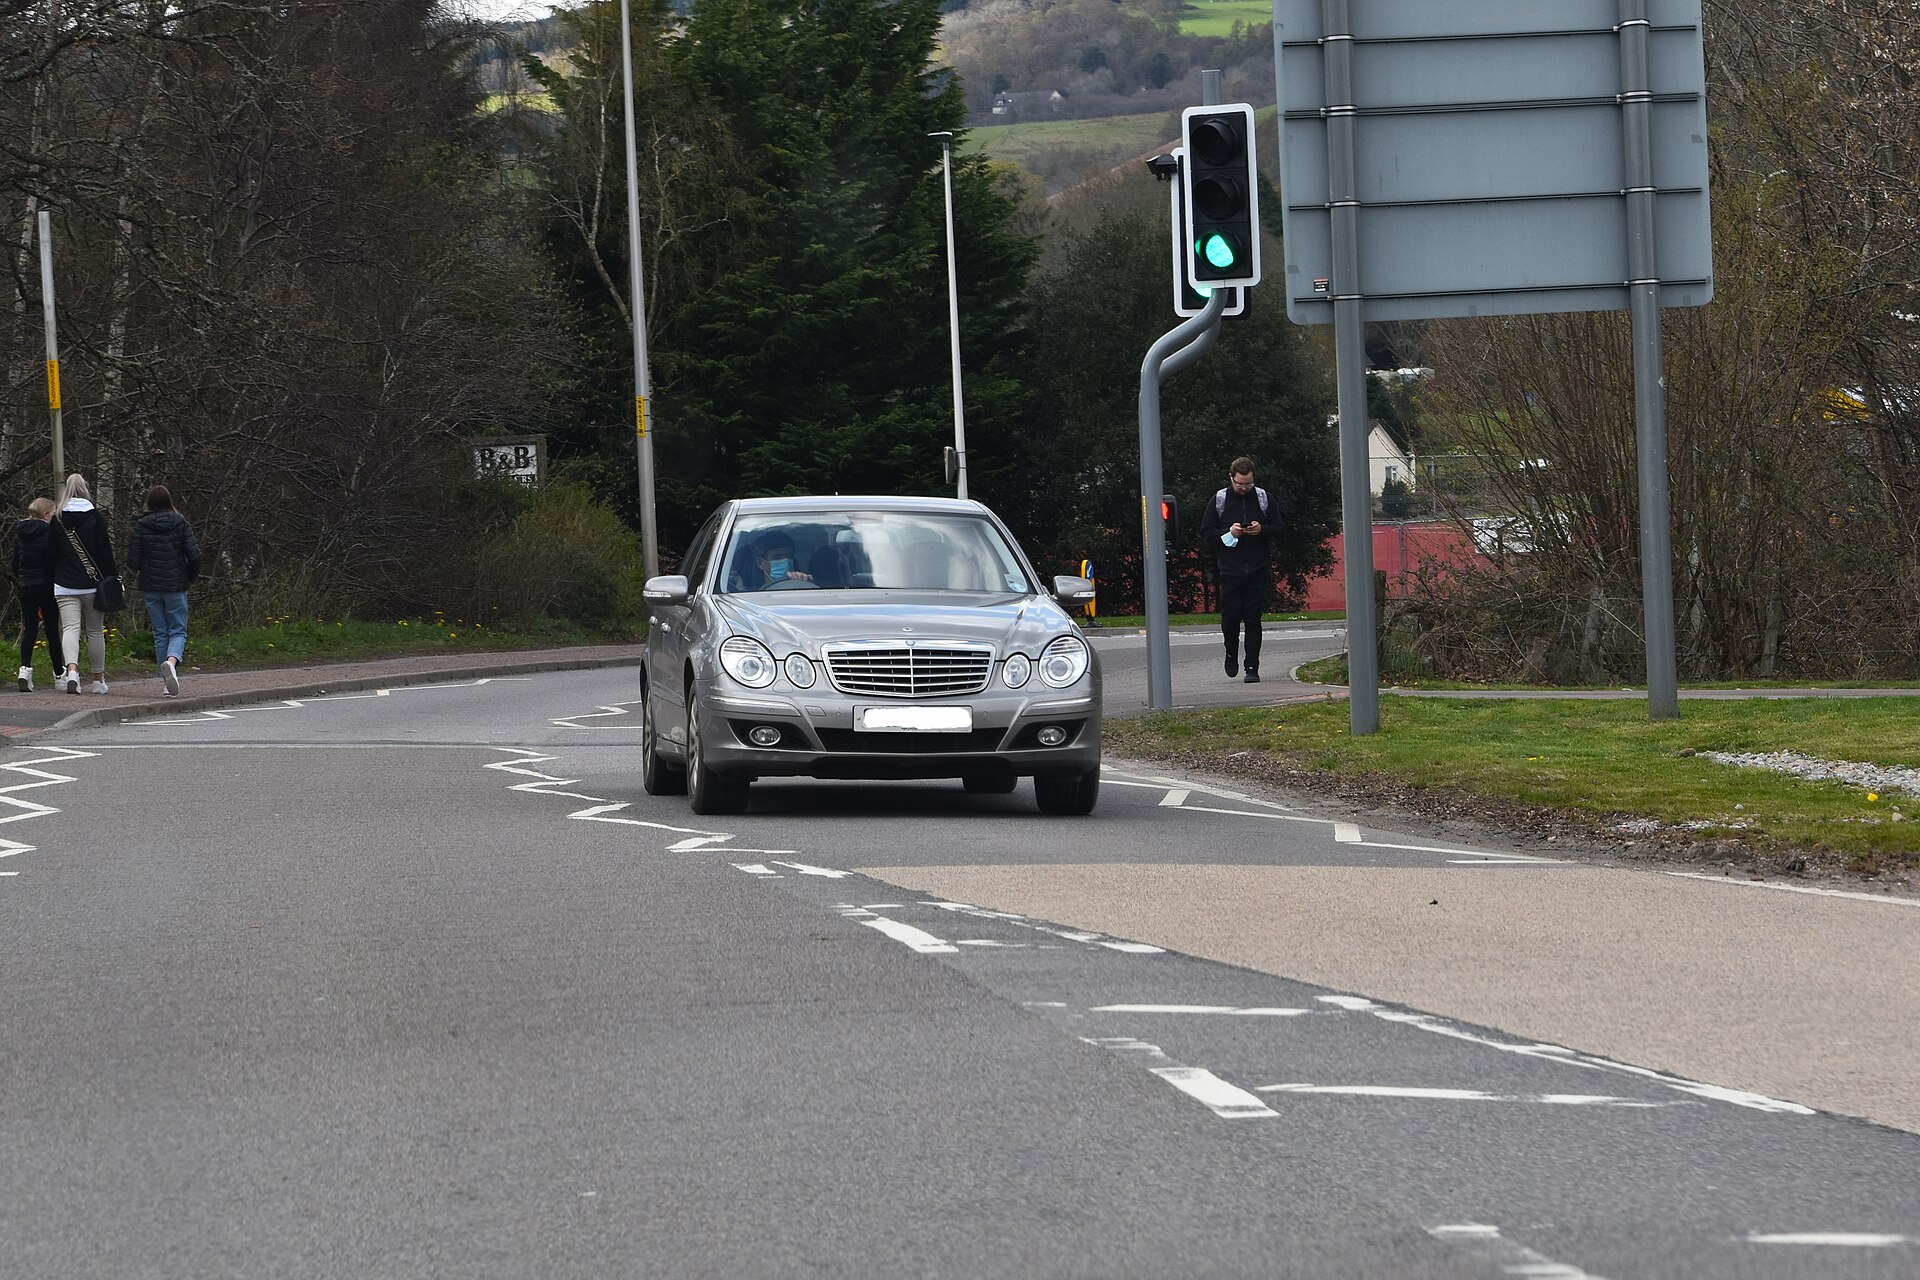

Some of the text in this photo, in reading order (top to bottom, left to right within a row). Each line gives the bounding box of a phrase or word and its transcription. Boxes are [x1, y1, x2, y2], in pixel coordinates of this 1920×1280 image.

[480, 447, 530, 469] B & B
